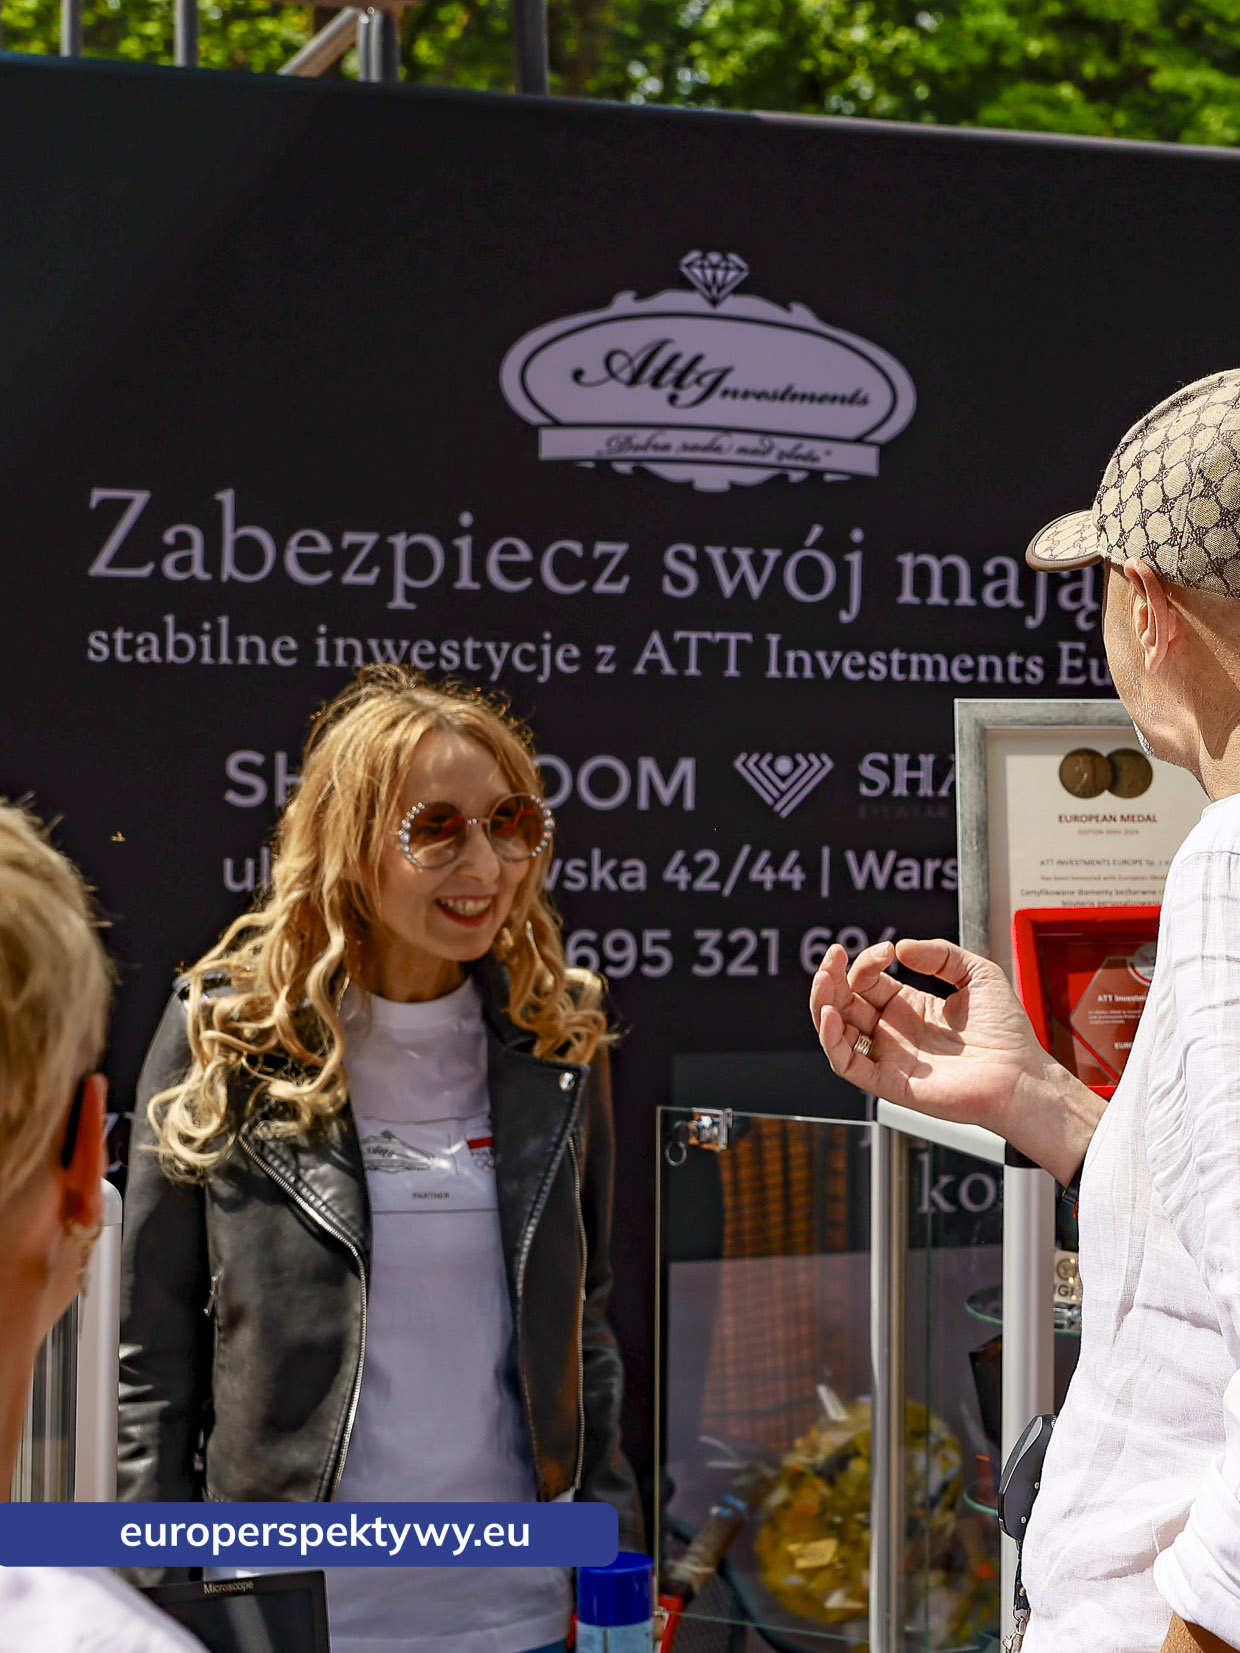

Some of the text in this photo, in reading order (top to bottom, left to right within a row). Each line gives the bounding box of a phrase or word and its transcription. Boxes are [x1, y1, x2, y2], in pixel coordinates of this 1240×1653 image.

[87, 486, 1099, 632] Zabezpiecz swój mają
[87, 613, 1113, 686] stabilne inwestycje z ATT Investments Eu
[1058, 813, 1158, 824] EUROPEAN MEDAL
[662, 844, 806, 898] 42/44
[844, 850, 958, 892] Wars
[565, 928, 674, 978] 695
[691, 928, 780, 977] 321
[917, 1151, 1003, 1214] ko
[203, 1580, 255, 1595] Microscope
